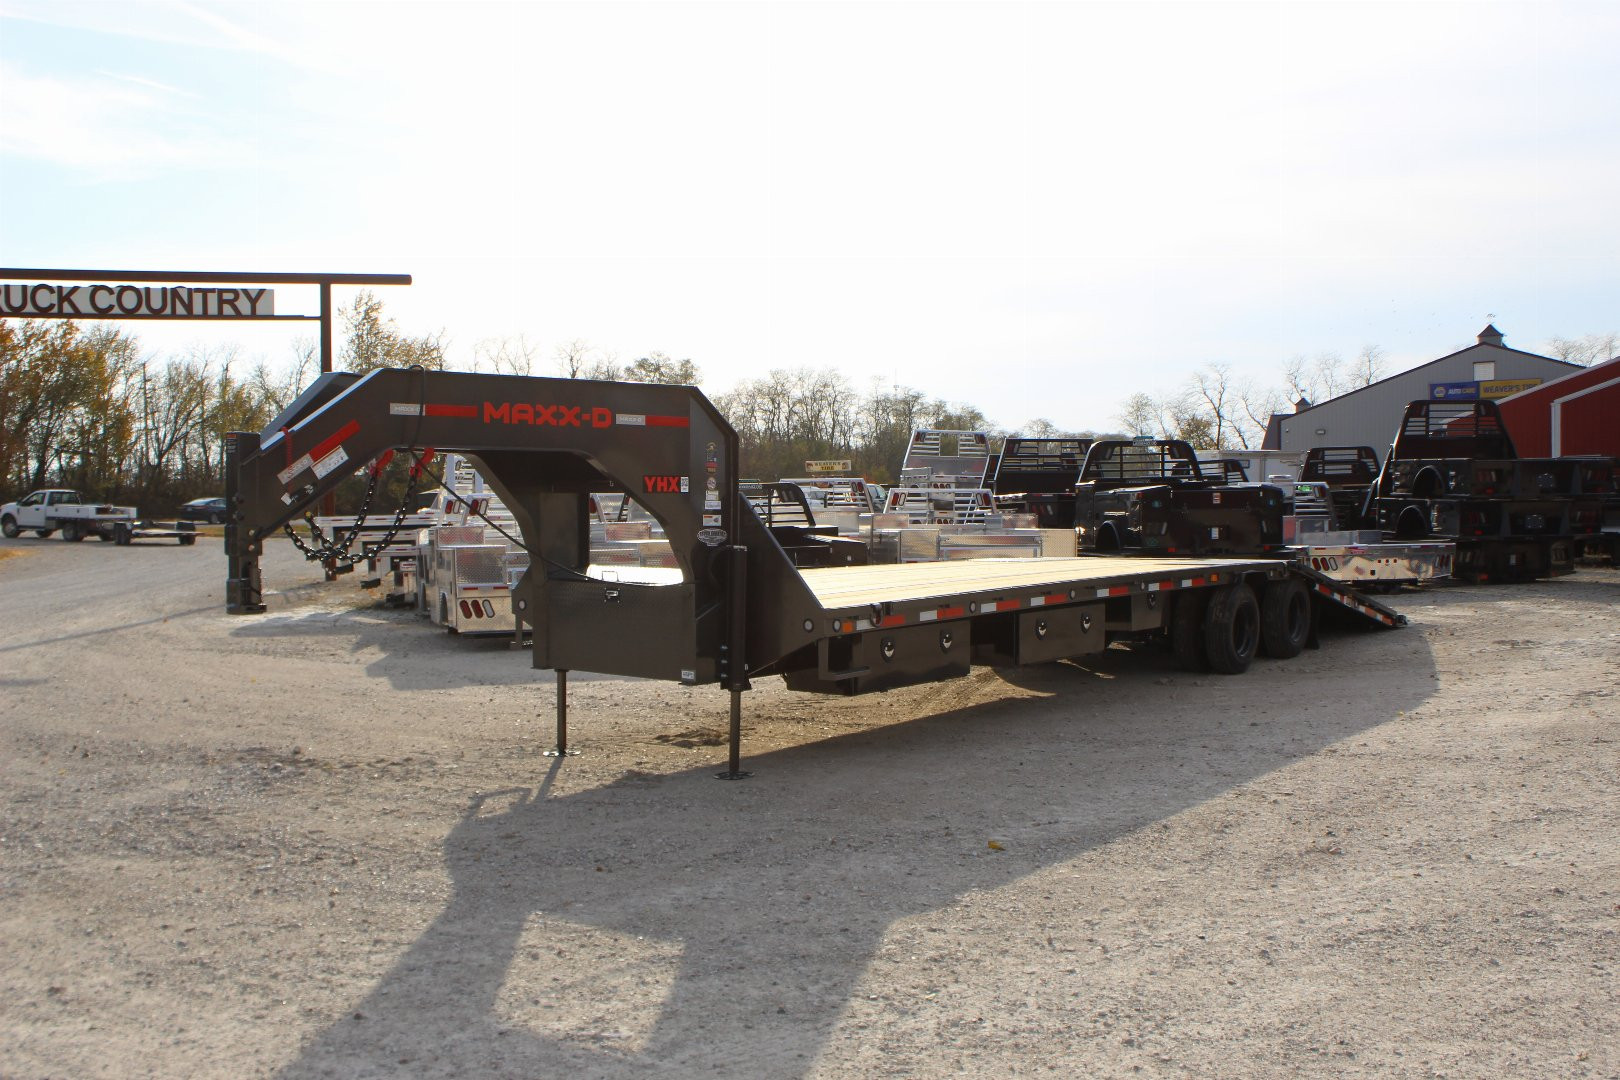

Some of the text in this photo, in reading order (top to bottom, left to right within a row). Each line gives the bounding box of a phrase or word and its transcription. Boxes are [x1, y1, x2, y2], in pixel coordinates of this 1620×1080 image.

[0, 284, 266, 316] UCK COUNTRY
[483, 402, 612, 428] MAXX-D
[644, 476, 680, 493] YHX
